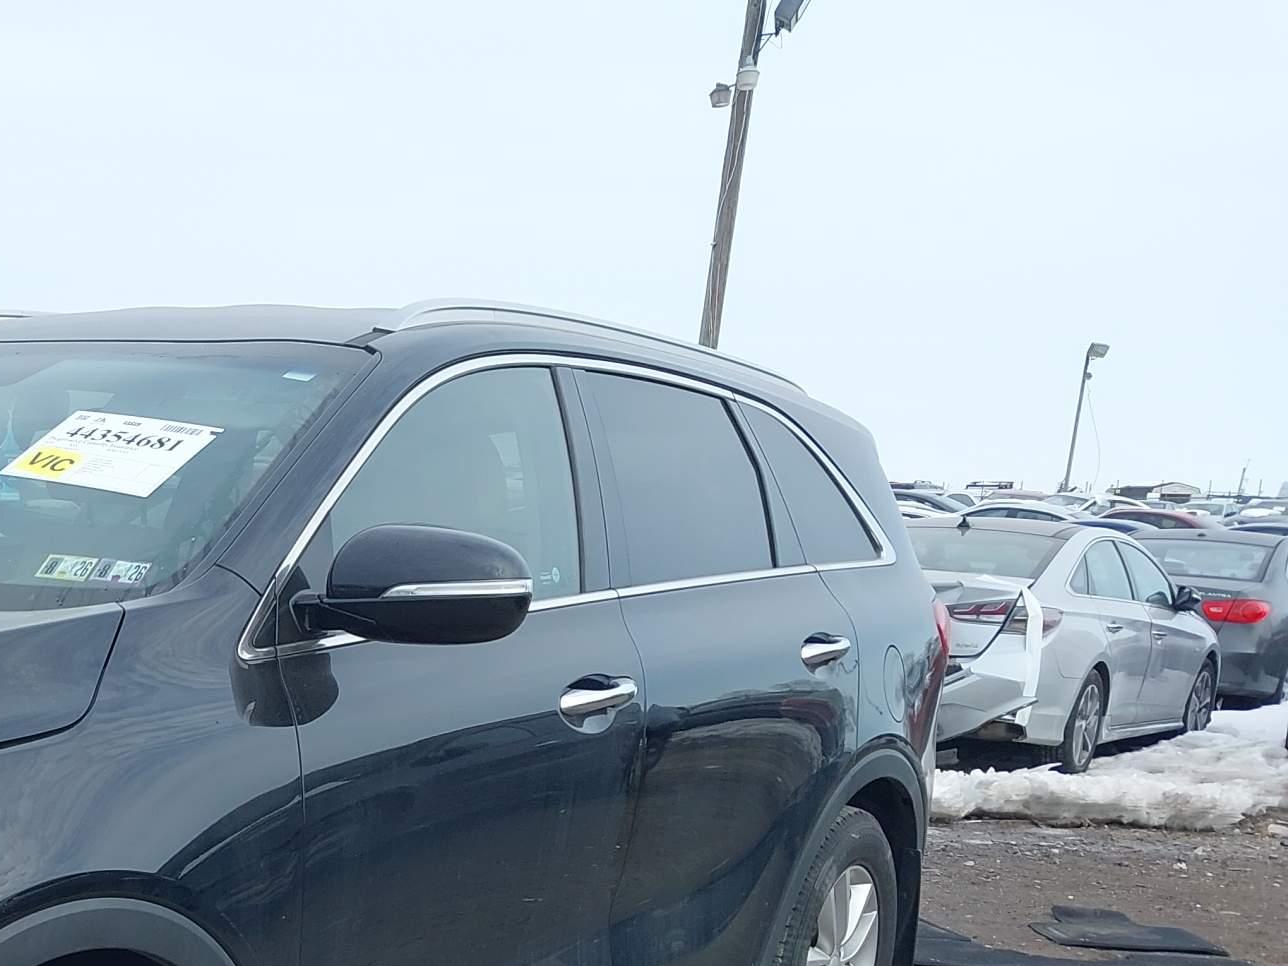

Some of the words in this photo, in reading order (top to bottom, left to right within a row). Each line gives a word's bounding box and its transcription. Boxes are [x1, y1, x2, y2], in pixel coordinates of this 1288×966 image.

[66, 426, 184, 451] 44354681
[28, 451, 75, 472] VIC
[74, 560, 93, 577] 26
[128, 564, 148, 581] 26
